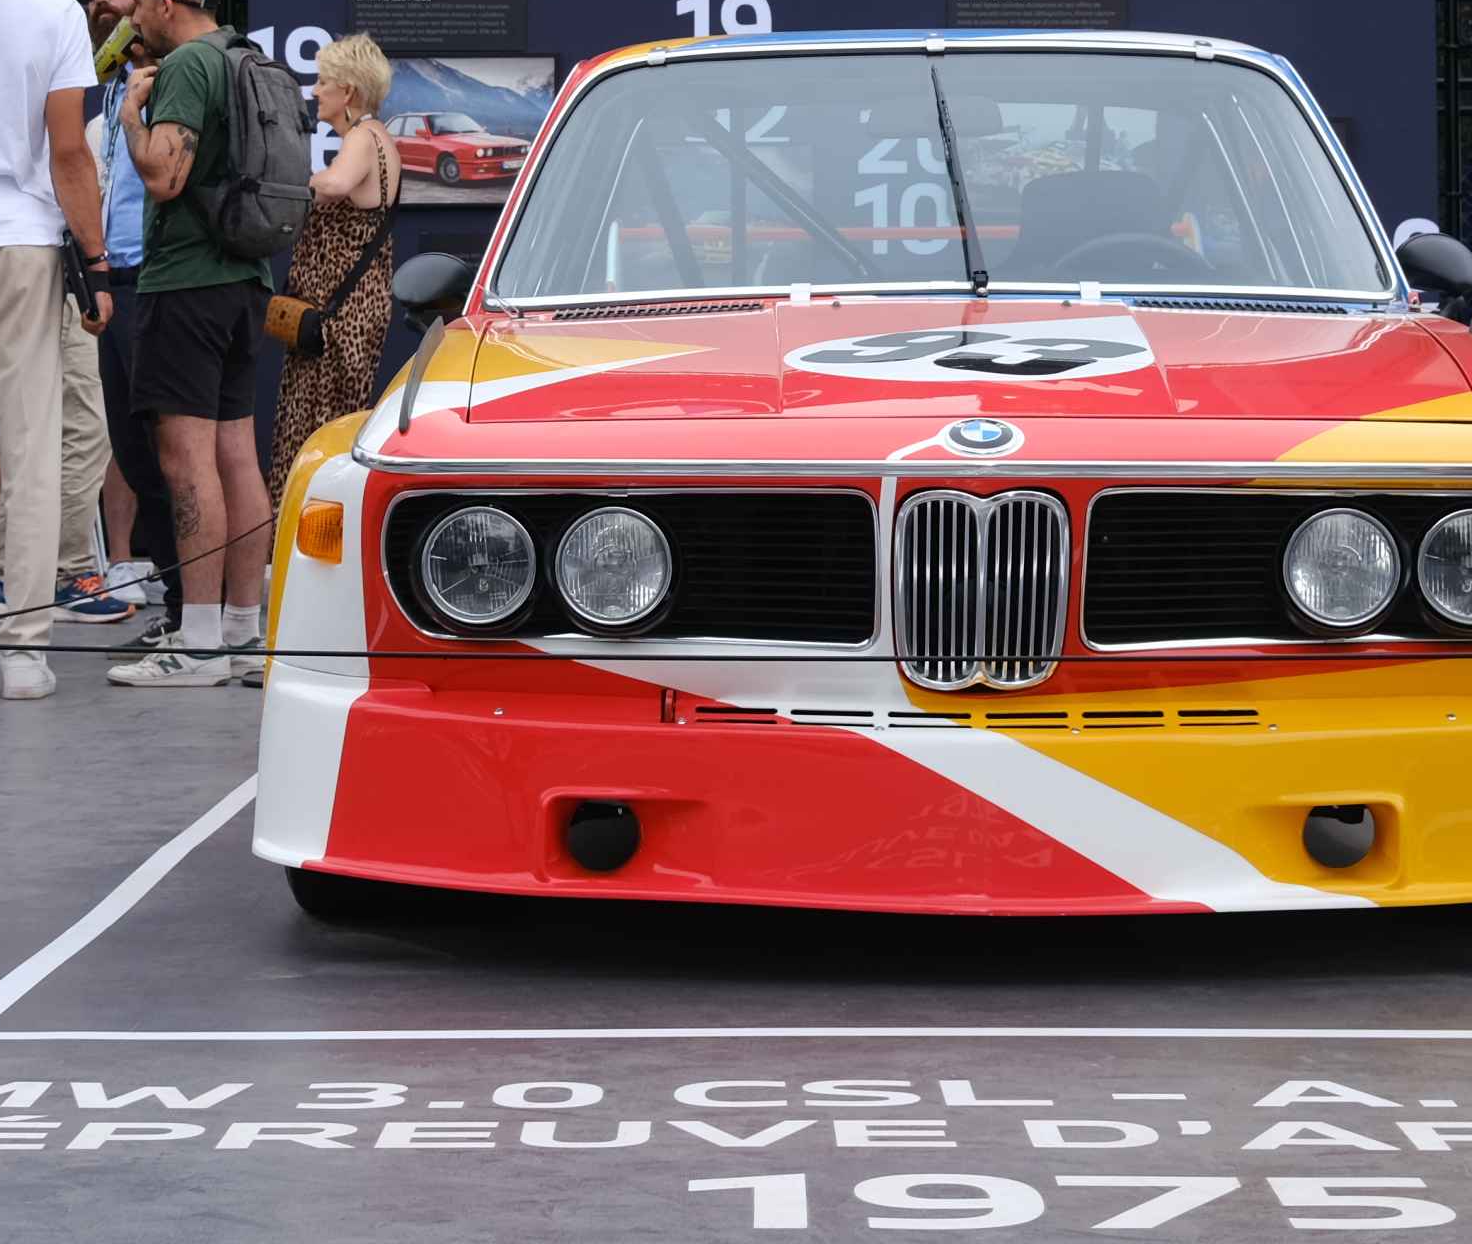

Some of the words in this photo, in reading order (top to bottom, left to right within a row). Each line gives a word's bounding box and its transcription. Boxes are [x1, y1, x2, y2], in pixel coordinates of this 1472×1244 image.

[854, 181, 953, 256] 10
[799, 330, 1148, 376] 93
[295, 1081, 605, 1110] 3.0
[673, 1079, 1055, 1108] CSL
[1252, 1080, 1458, 1108] A.
[687, 1172, 1457, 1231] 1975
